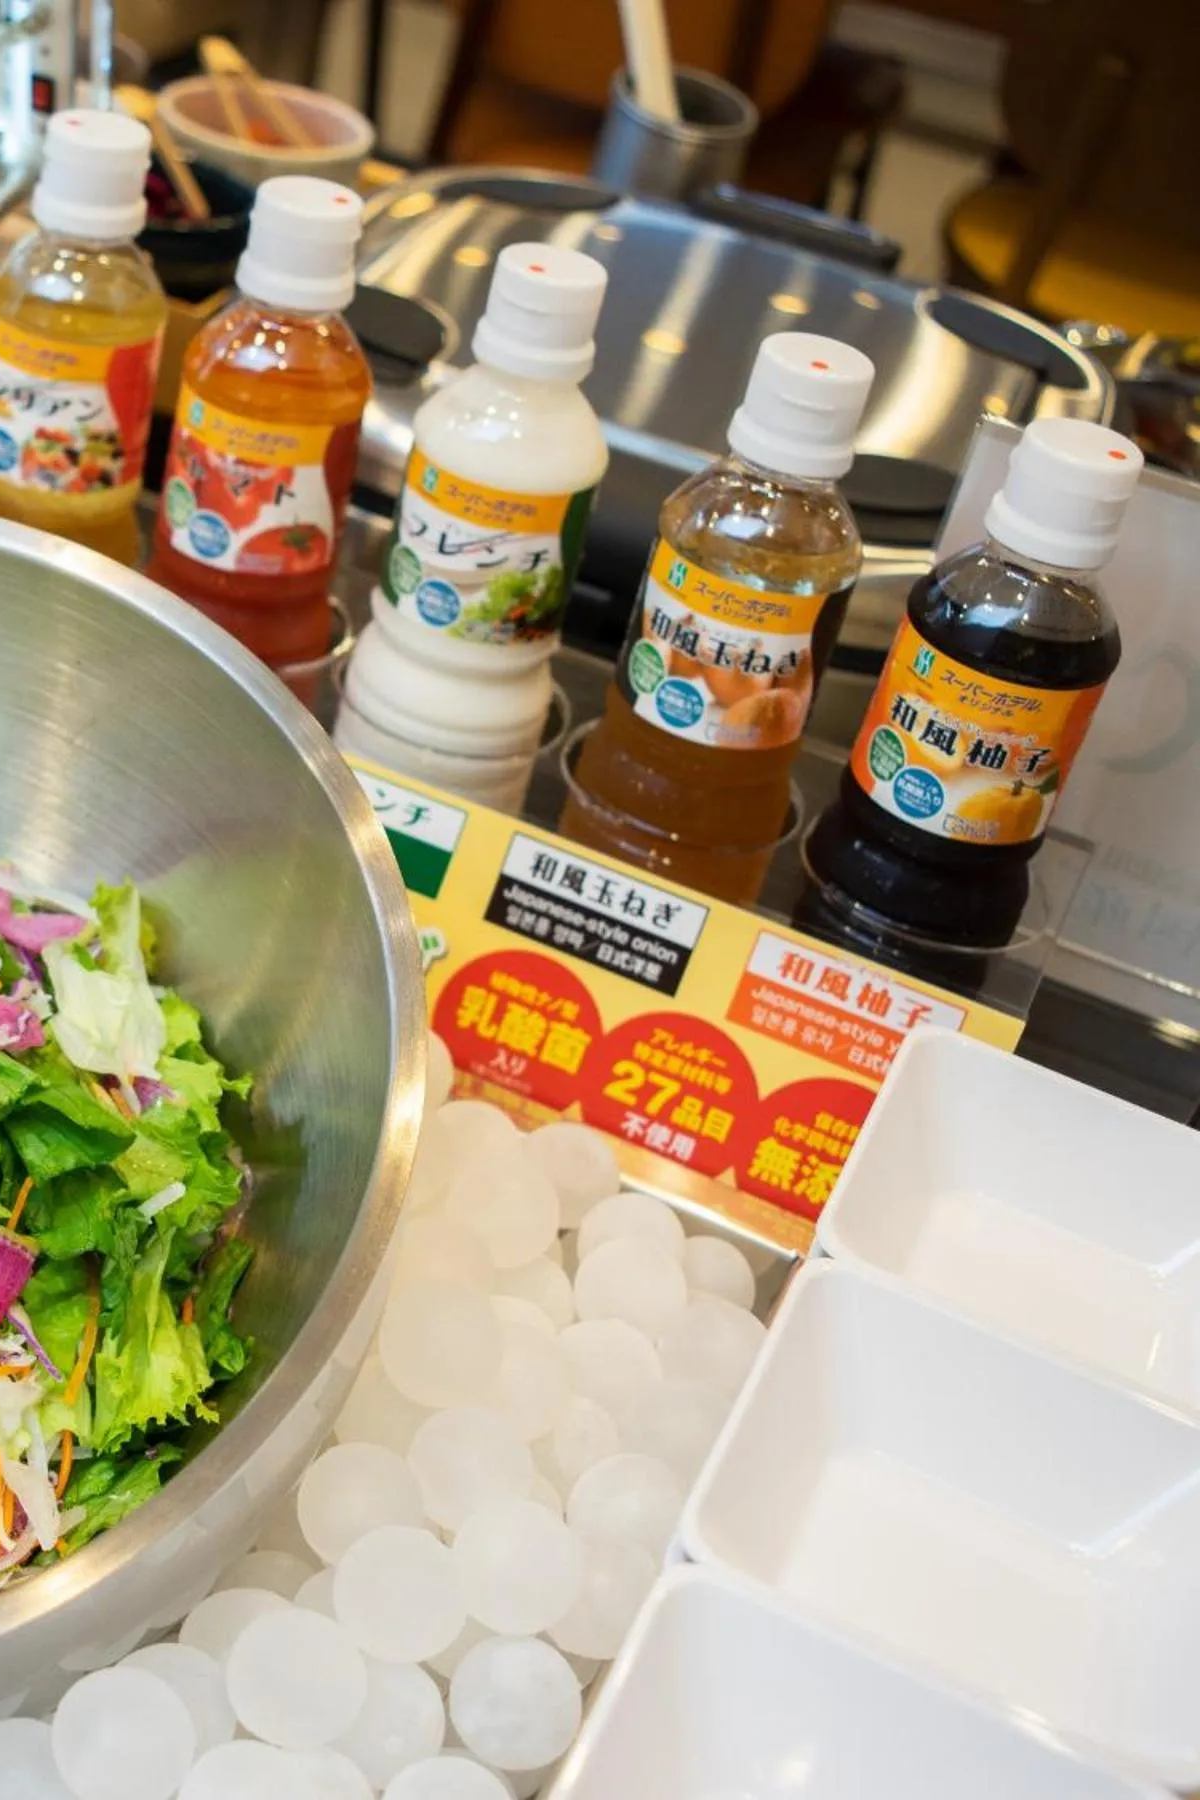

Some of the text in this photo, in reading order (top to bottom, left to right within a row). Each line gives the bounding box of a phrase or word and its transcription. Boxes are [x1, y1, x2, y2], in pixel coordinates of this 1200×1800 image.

[651, 606, 801, 677] 和風玉ねぎ
[940, 668, 1043, 713] スーパーホテル
[890, 693, 1052, 774] 和風柚子
[503, 883, 679, 965] Japanese-style onion
[529, 852, 683, 929] 和風玉ねぎ
[751, 984, 886, 1048] Japanese-style
[777, 951, 933, 1029] 和風柚子
[457, 984, 593, 1077] 乳酸菌
[602, 1059, 735, 1144] 27品目
[620, 1110, 697, 1161] 不使用
